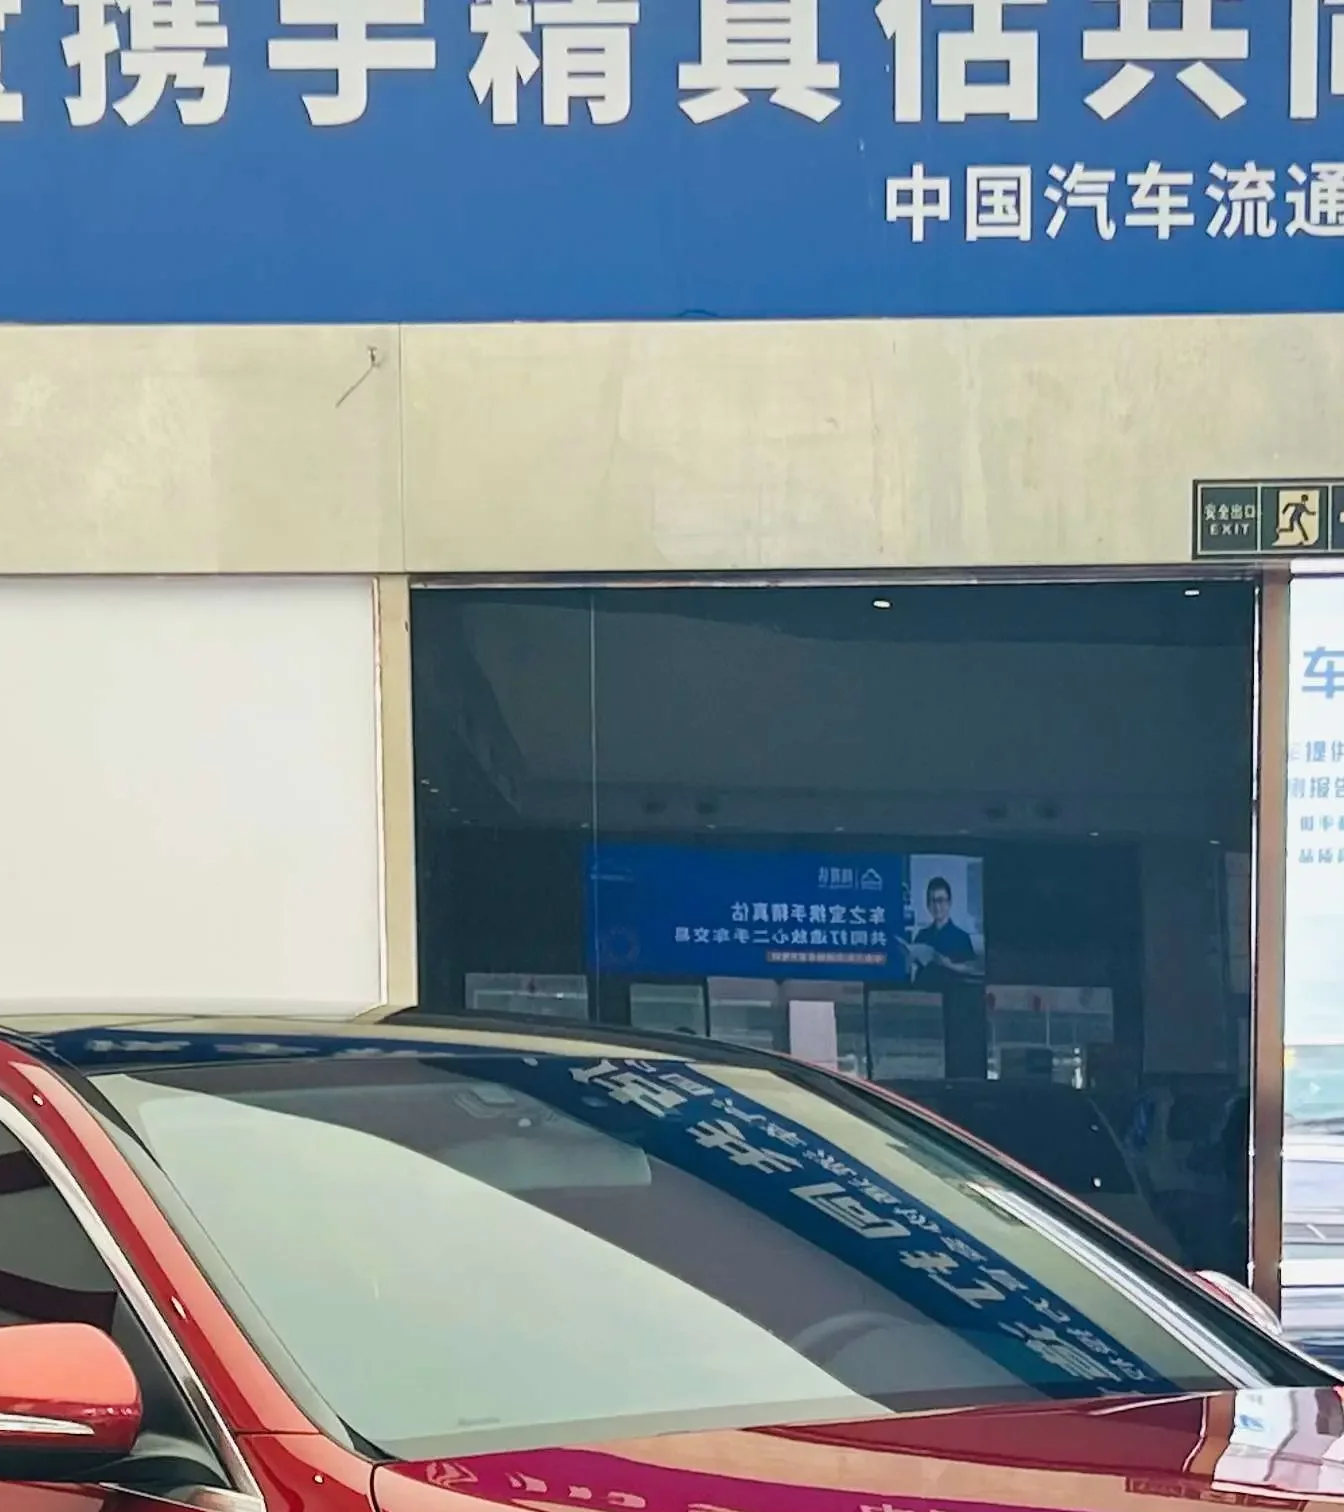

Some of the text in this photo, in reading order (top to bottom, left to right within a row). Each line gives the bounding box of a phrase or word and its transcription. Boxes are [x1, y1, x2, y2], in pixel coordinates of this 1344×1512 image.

[1205, 503, 1256, 520] 安全出口
[1210, 523, 1250, 536] EXIT
